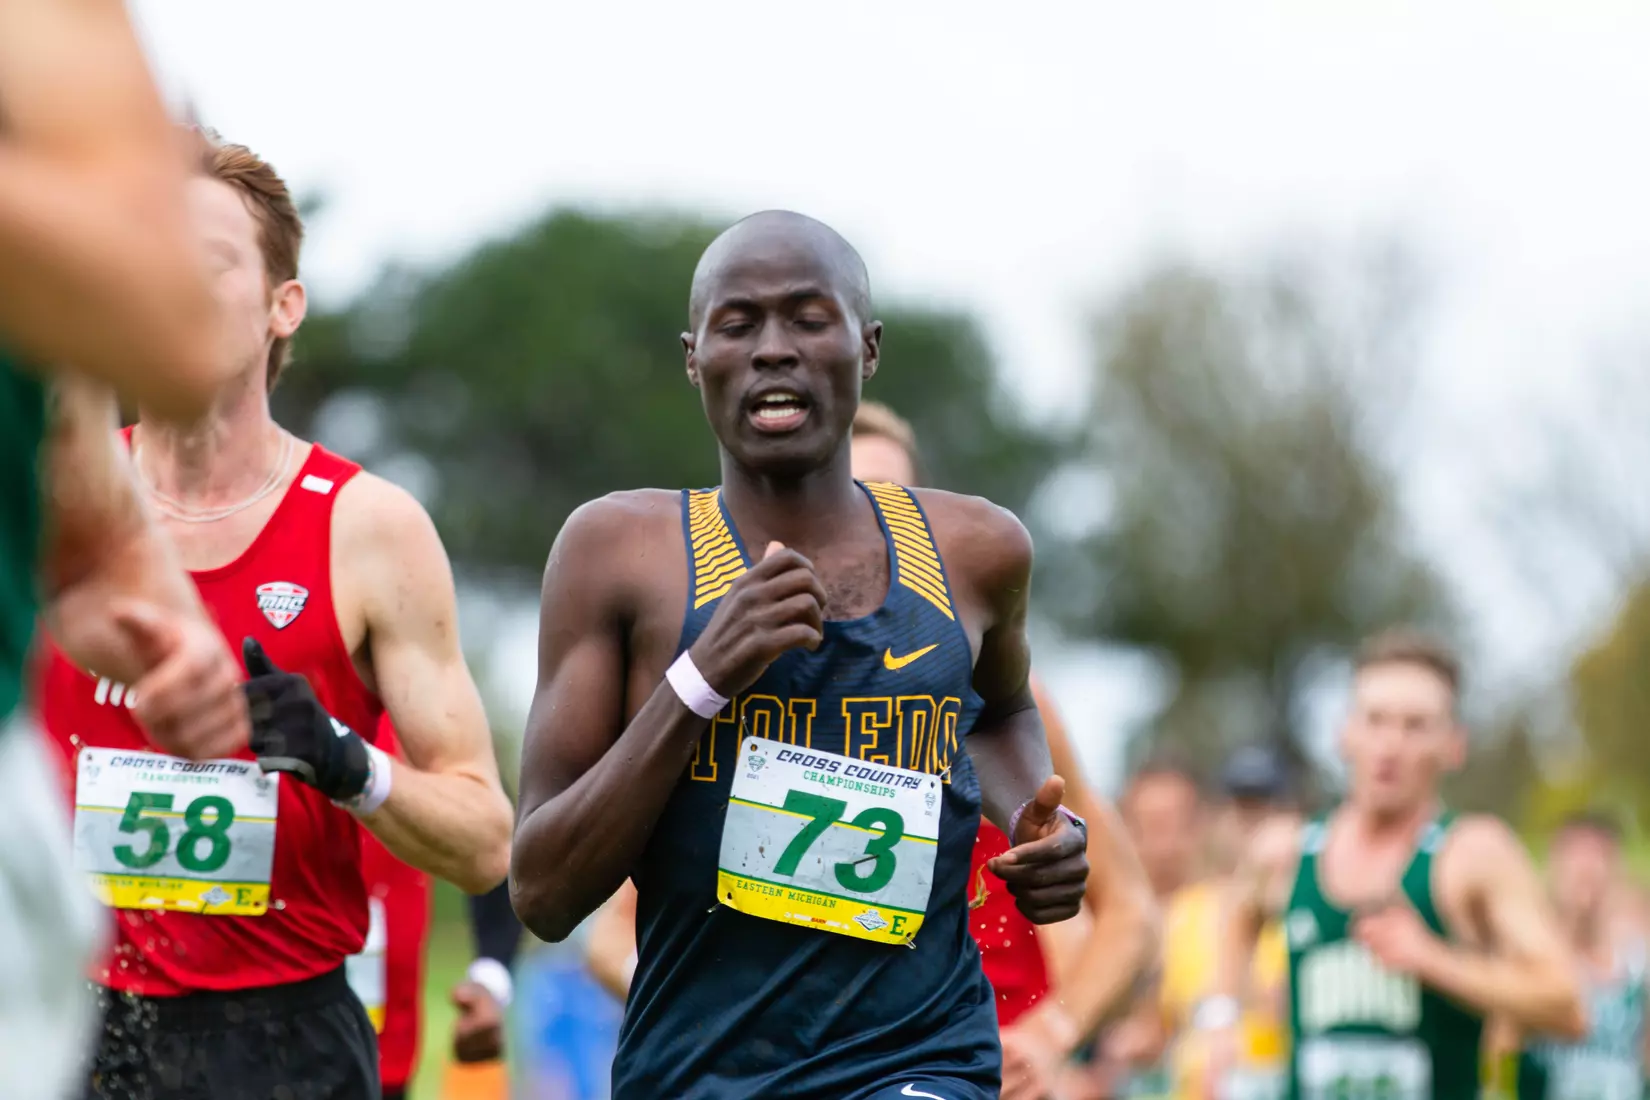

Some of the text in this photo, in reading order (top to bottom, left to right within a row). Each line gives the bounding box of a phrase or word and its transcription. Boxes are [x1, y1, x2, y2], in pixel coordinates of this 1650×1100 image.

[110, 756, 251, 776] CROSS COUNTRY
[776, 748, 842, 773] CROSS
[843, 762, 922, 790] COUNTRY
[803, 770, 896, 799] CHAMPIONSHIPS
[112, 791, 236, 873] 58
[773, 788, 905, 895] 73
[236, 888, 254, 907] E
[736, 879, 837, 909] EASTERN MICHIGAN
[889, 915, 907, 936] E
